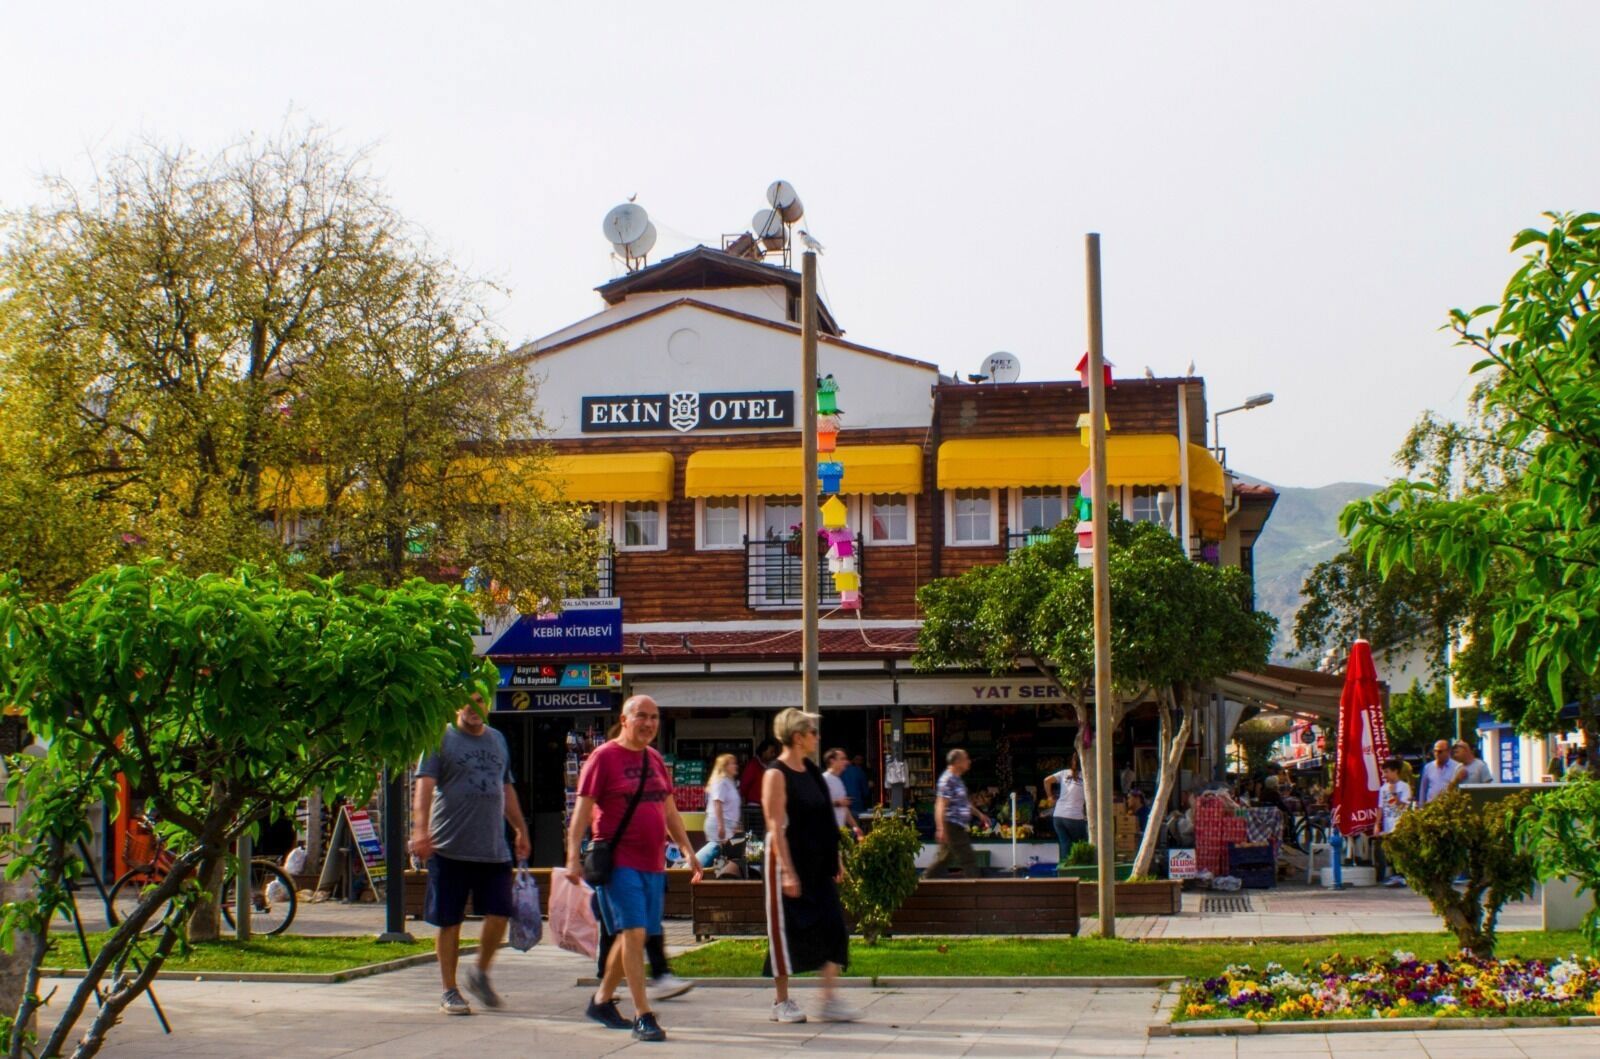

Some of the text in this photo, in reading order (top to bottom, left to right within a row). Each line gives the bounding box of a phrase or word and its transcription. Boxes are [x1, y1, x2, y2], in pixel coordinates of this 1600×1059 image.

[590, 399, 784, 424] EKİN OTEL
[533, 624, 612, 638] KEBİR KİTABEVİ
[517, 666, 540, 675] Bayrak
[972, 685, 1096, 698] YAT SERS
[535, 693, 602, 706] TURKCELL
[1351, 807, 1377, 822] ADIN
